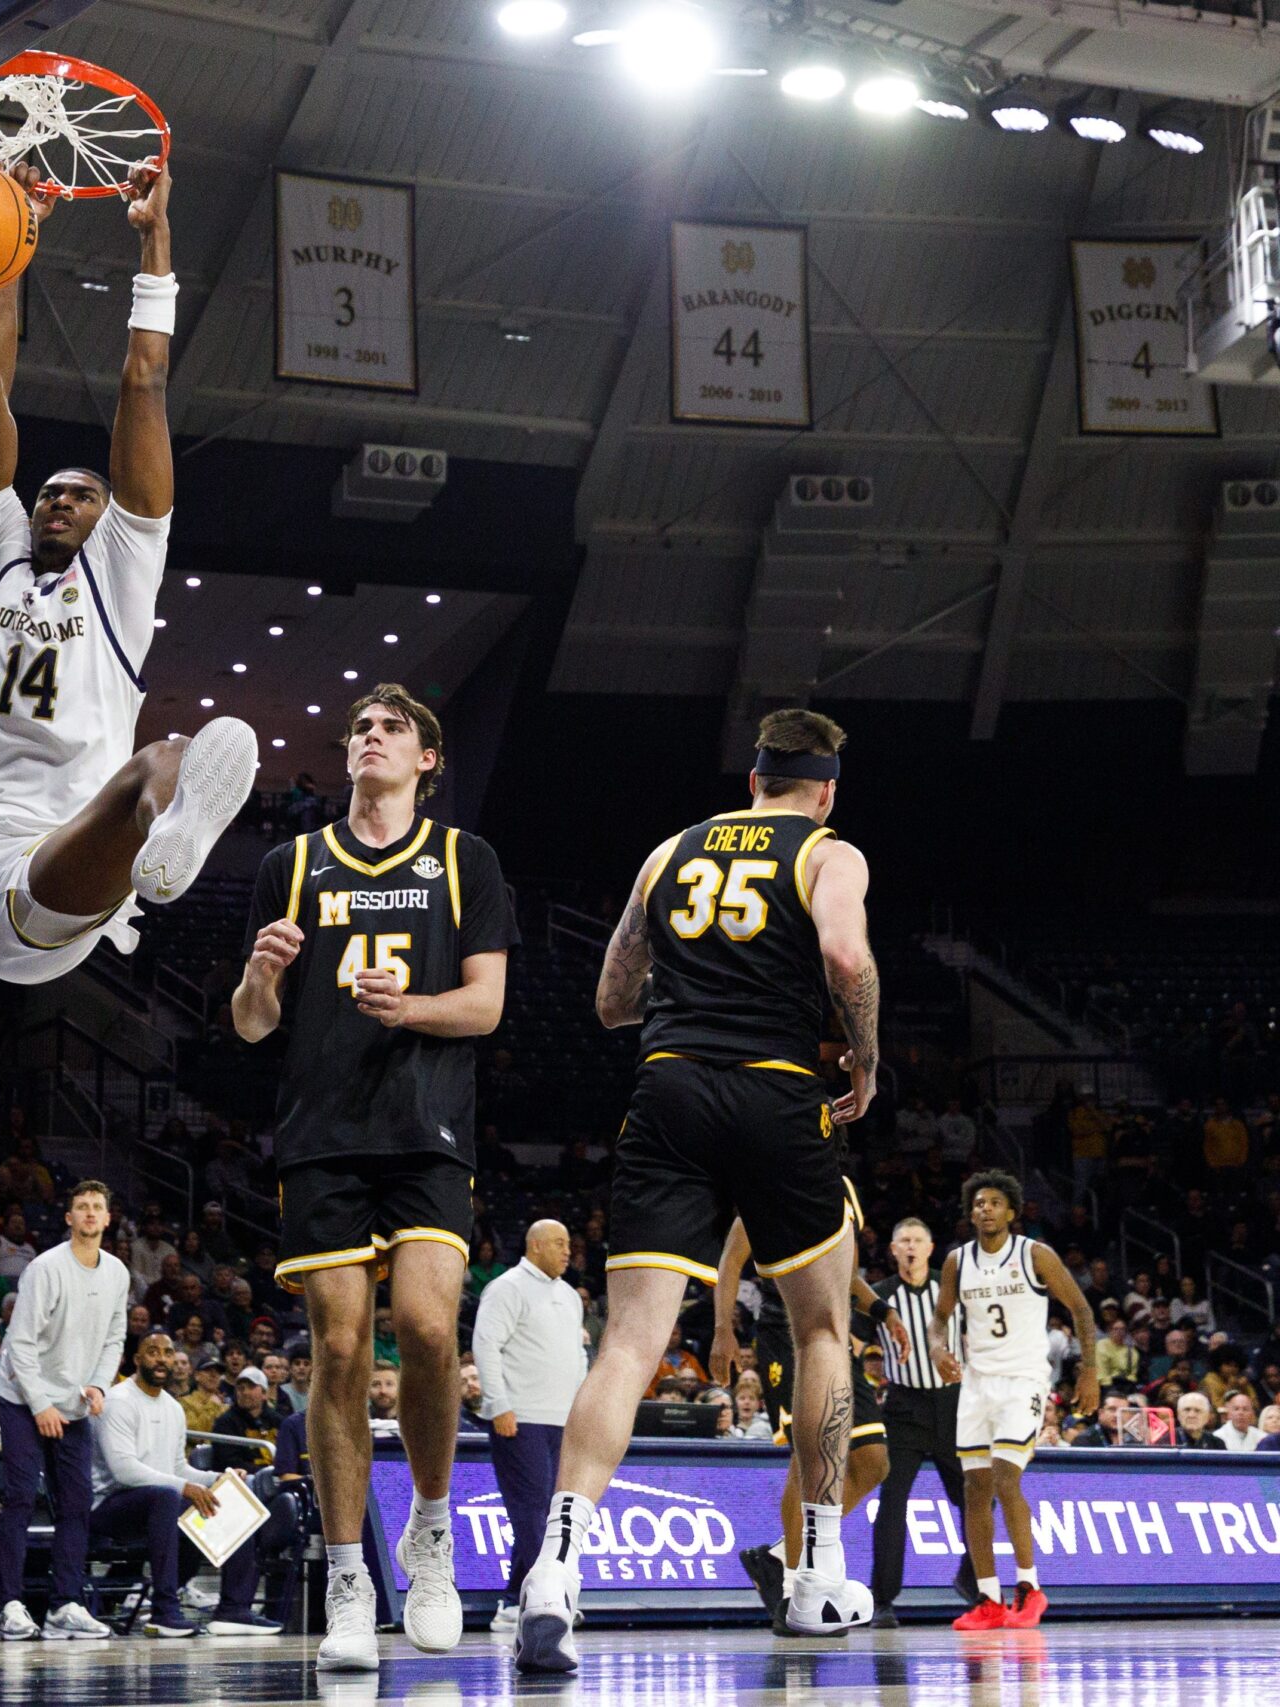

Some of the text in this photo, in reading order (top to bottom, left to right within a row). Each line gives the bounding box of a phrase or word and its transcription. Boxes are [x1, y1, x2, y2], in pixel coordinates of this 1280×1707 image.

[292, 245, 400, 276] MURPHY
[335, 287, 356, 328] 3
[681, 288, 798, 318] HARANGODY
[1088, 302, 1184, 327] DIGGIN
[713, 326, 764, 367] 44
[1132, 341, 1156, 380] 4
[703, 825, 775, 852] CREWS
[417, 855, 440, 873] SEC
[319, 888, 429, 927] MISSOURI
[669, 857, 779, 942] 35
[336, 933, 412, 998] 45
[962, 1283, 1026, 1300] NOTRE DAME
[987, 1304, 1008, 1338] 3
[456, 1505, 736, 1556] TRBLOOD
[1031, 1500, 1173, 1555] WITH
[1175, 1501, 1280, 1555] TRU
[597, 1558, 718, 1580] ESTATE
